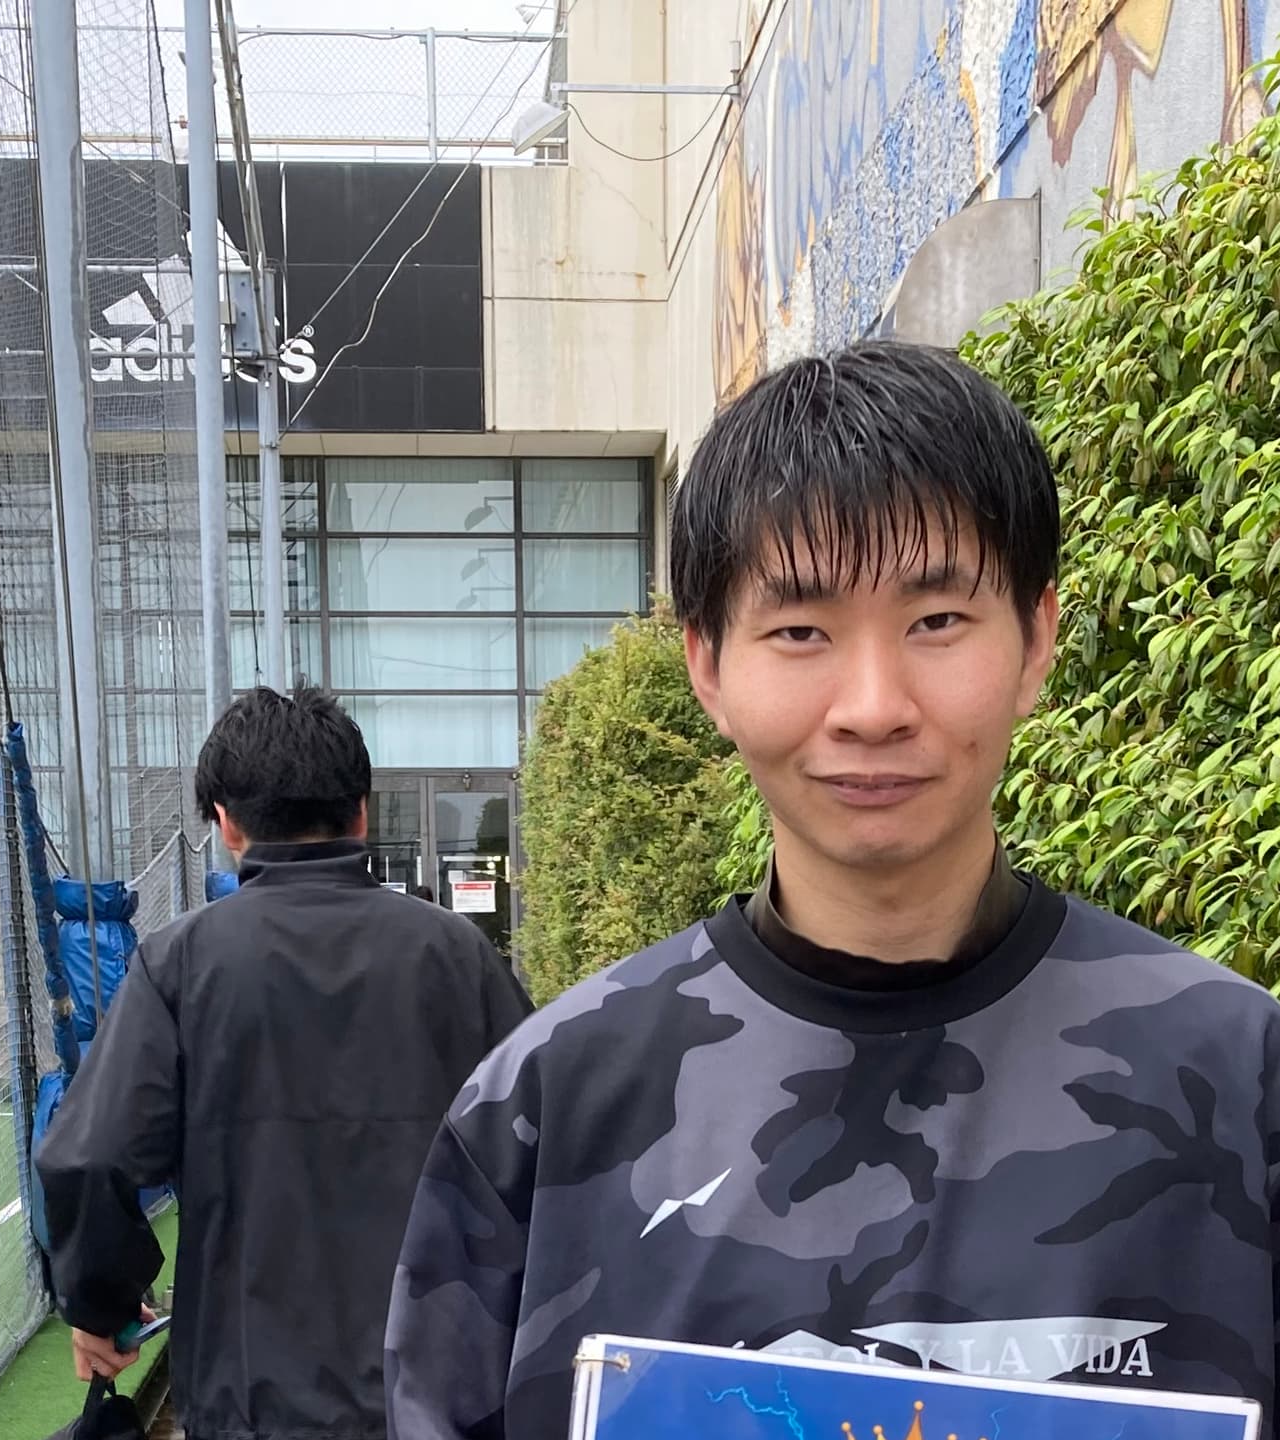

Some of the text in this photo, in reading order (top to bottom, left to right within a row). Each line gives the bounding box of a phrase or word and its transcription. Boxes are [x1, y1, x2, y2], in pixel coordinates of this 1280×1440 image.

[89, 323, 317, 384] adis
[957, 1338, 1031, 1377] LA
[1047, 1333, 1154, 1378] VIDA
